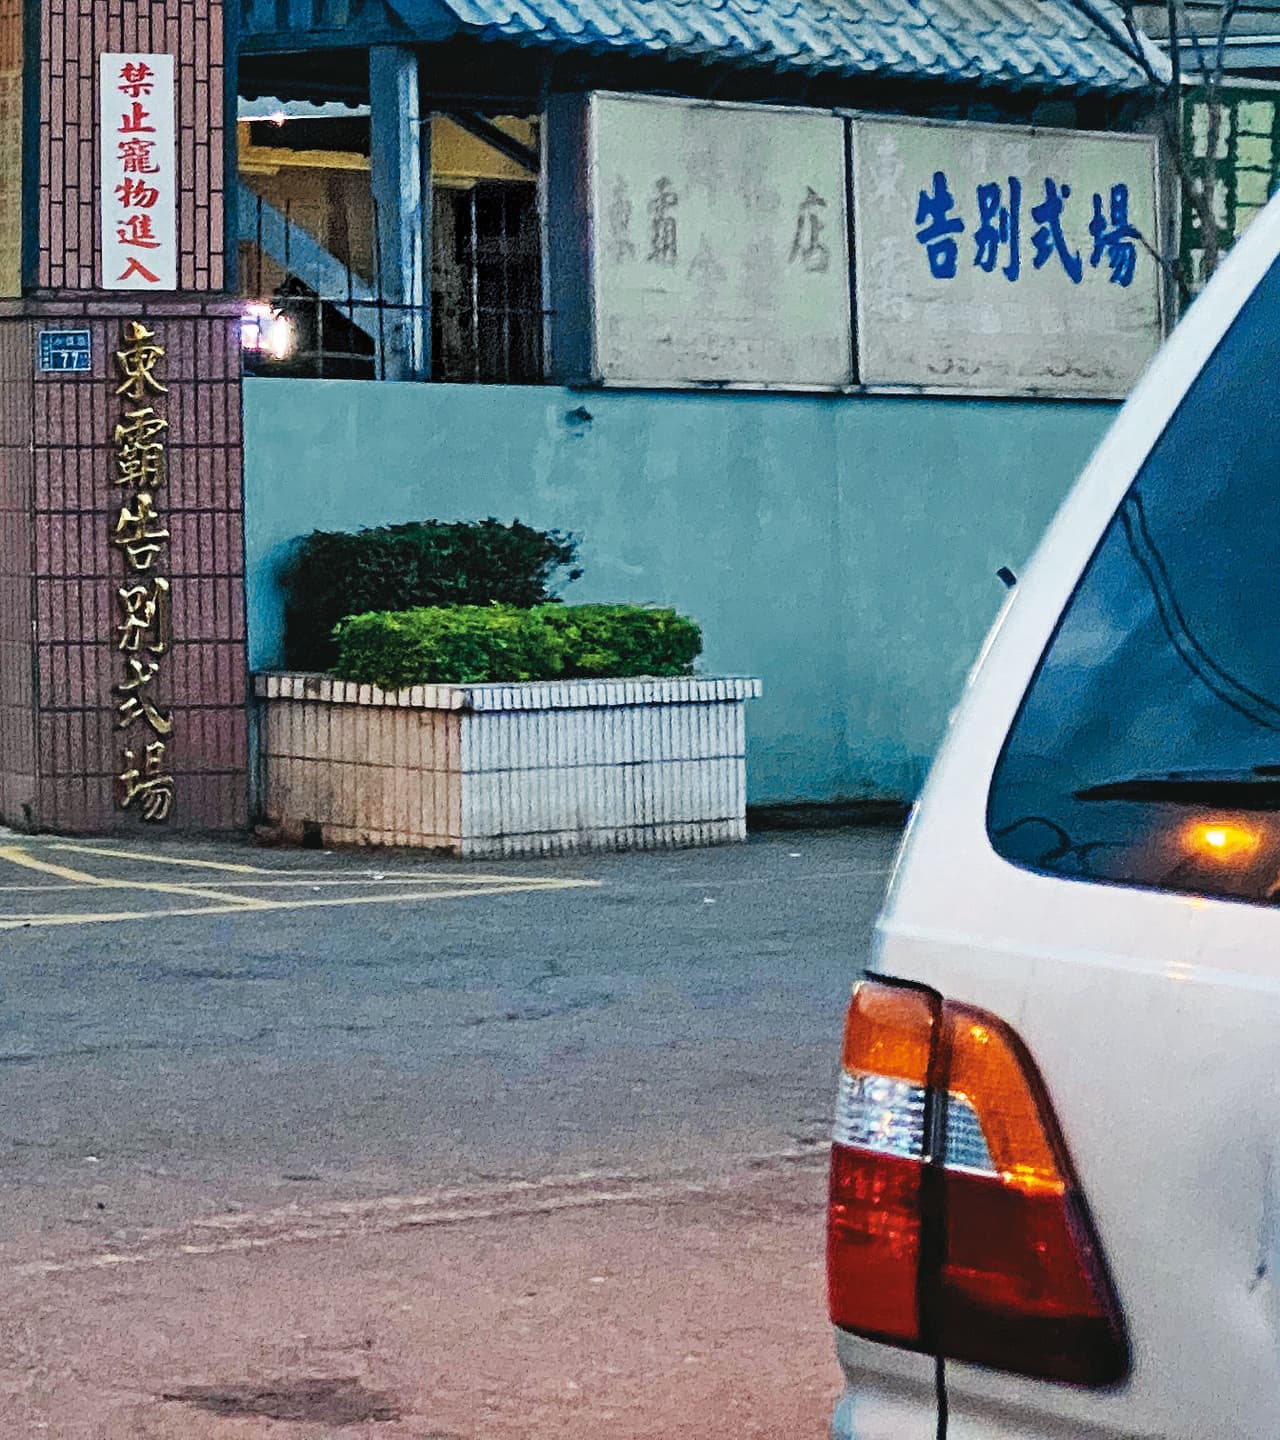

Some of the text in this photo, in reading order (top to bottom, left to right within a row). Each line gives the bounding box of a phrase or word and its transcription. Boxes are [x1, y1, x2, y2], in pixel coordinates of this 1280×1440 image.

[113, 61, 161, 283] 禁止寵物進入
[915, 170, 1143, 288] 告別式場
[114, 320, 175, 822] 東霸告別式場
